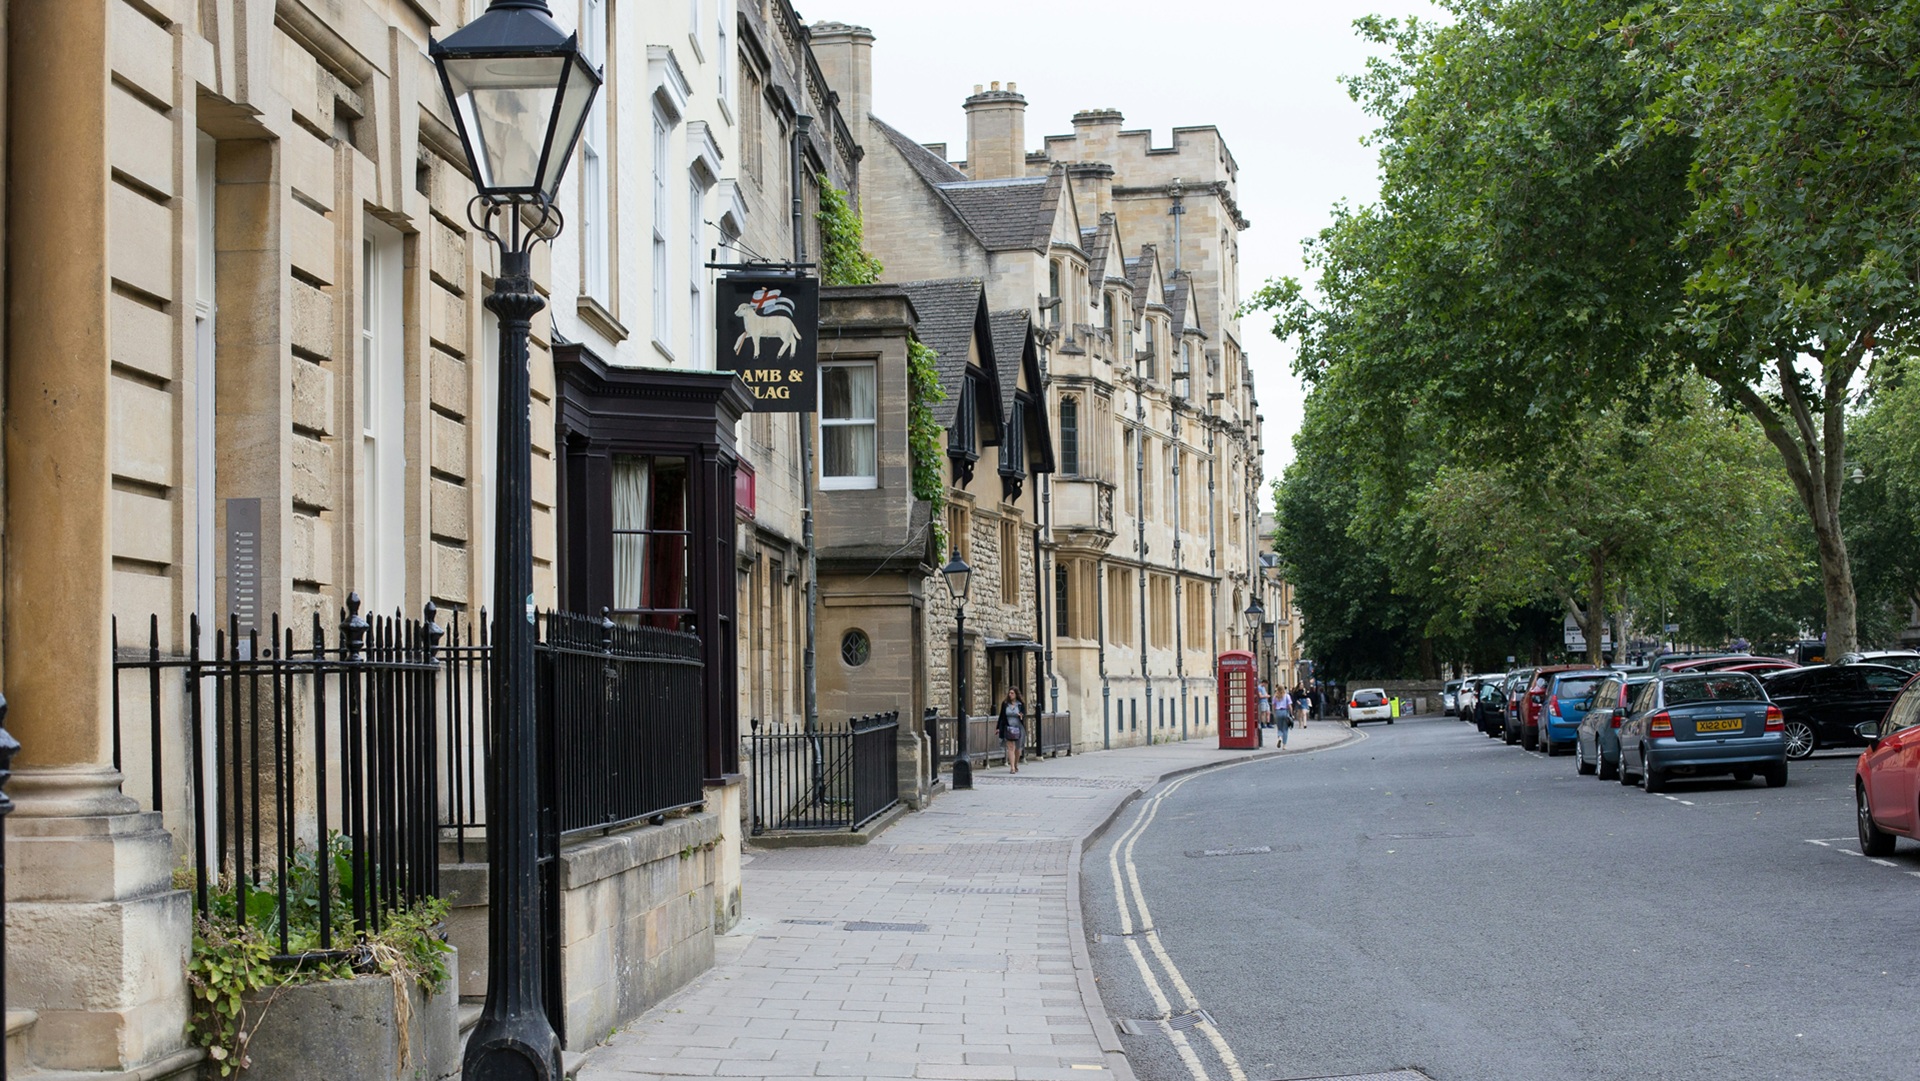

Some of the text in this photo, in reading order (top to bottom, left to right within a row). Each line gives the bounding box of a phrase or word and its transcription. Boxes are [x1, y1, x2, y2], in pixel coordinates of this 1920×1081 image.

[731, 369, 804, 382] AMB &
[1721, 719, 1739, 729] CVV
